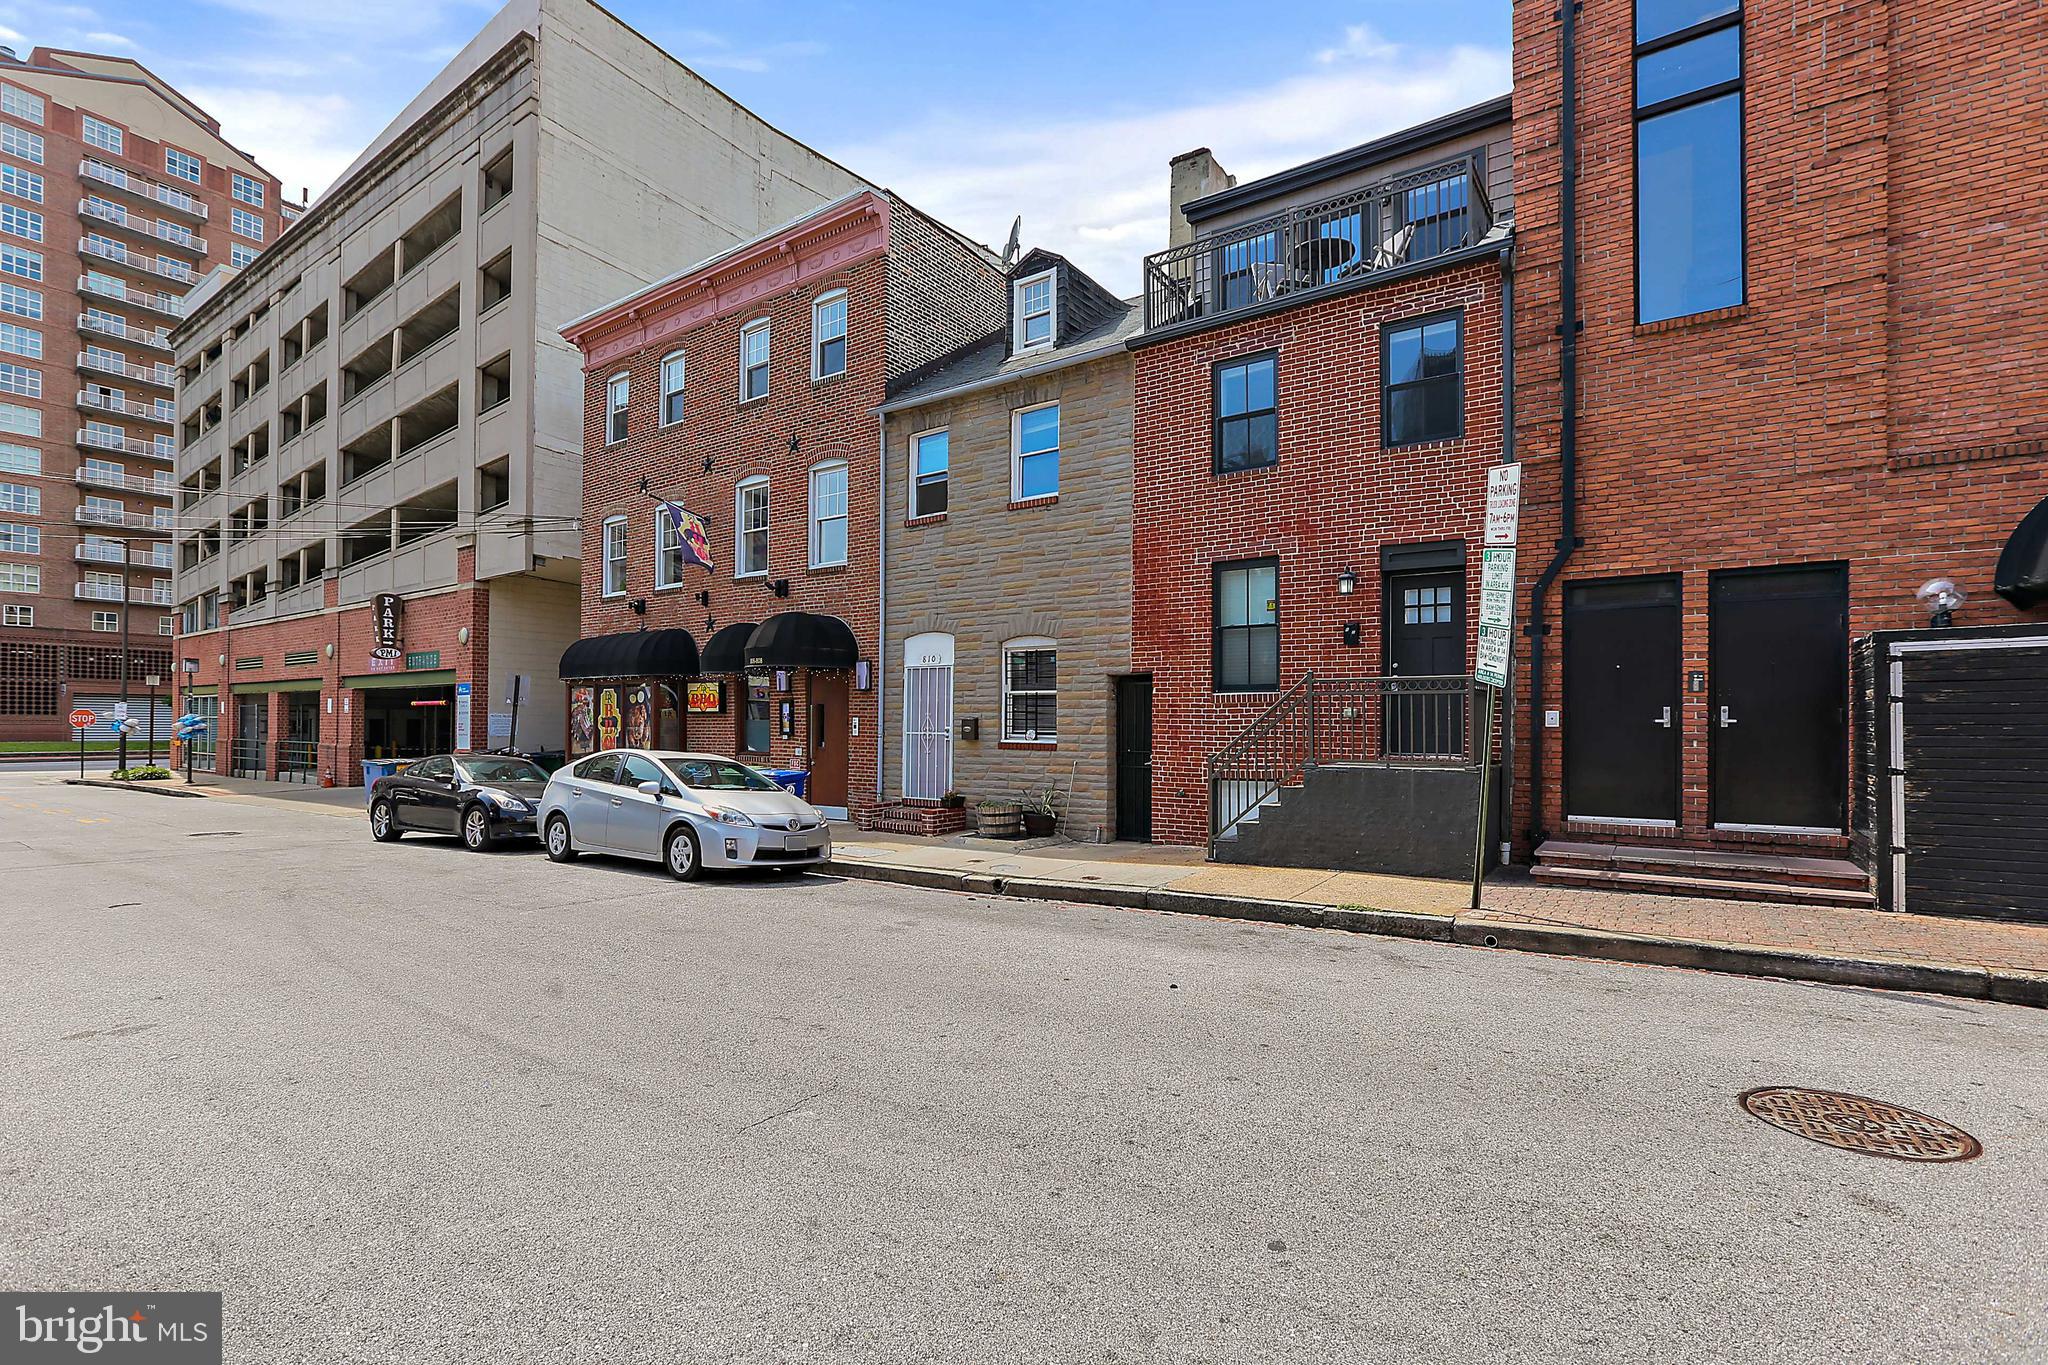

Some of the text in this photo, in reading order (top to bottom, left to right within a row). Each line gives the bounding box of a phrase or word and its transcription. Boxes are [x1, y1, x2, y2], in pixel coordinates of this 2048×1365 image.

[1499, 470, 1509, 482] NO
[1490, 483, 1517, 498] PARKING
[1489, 512, 1515, 524] 7AM-6PM
[1486, 551, 1512, 563] 3 HOUR
[1488, 563, 1509, 572] PARKING
[1492, 572, 1503, 580] LIMIT
[383, 596, 395, 639] PARK
[1482, 627, 1506, 641] 3 HOUR
[1481, 637, 1496, 646] PARKING
[380, 649, 398, 658] PMI
[1486, 645, 1496, 653] AREA
[691, 694, 717, 706] BBQ
